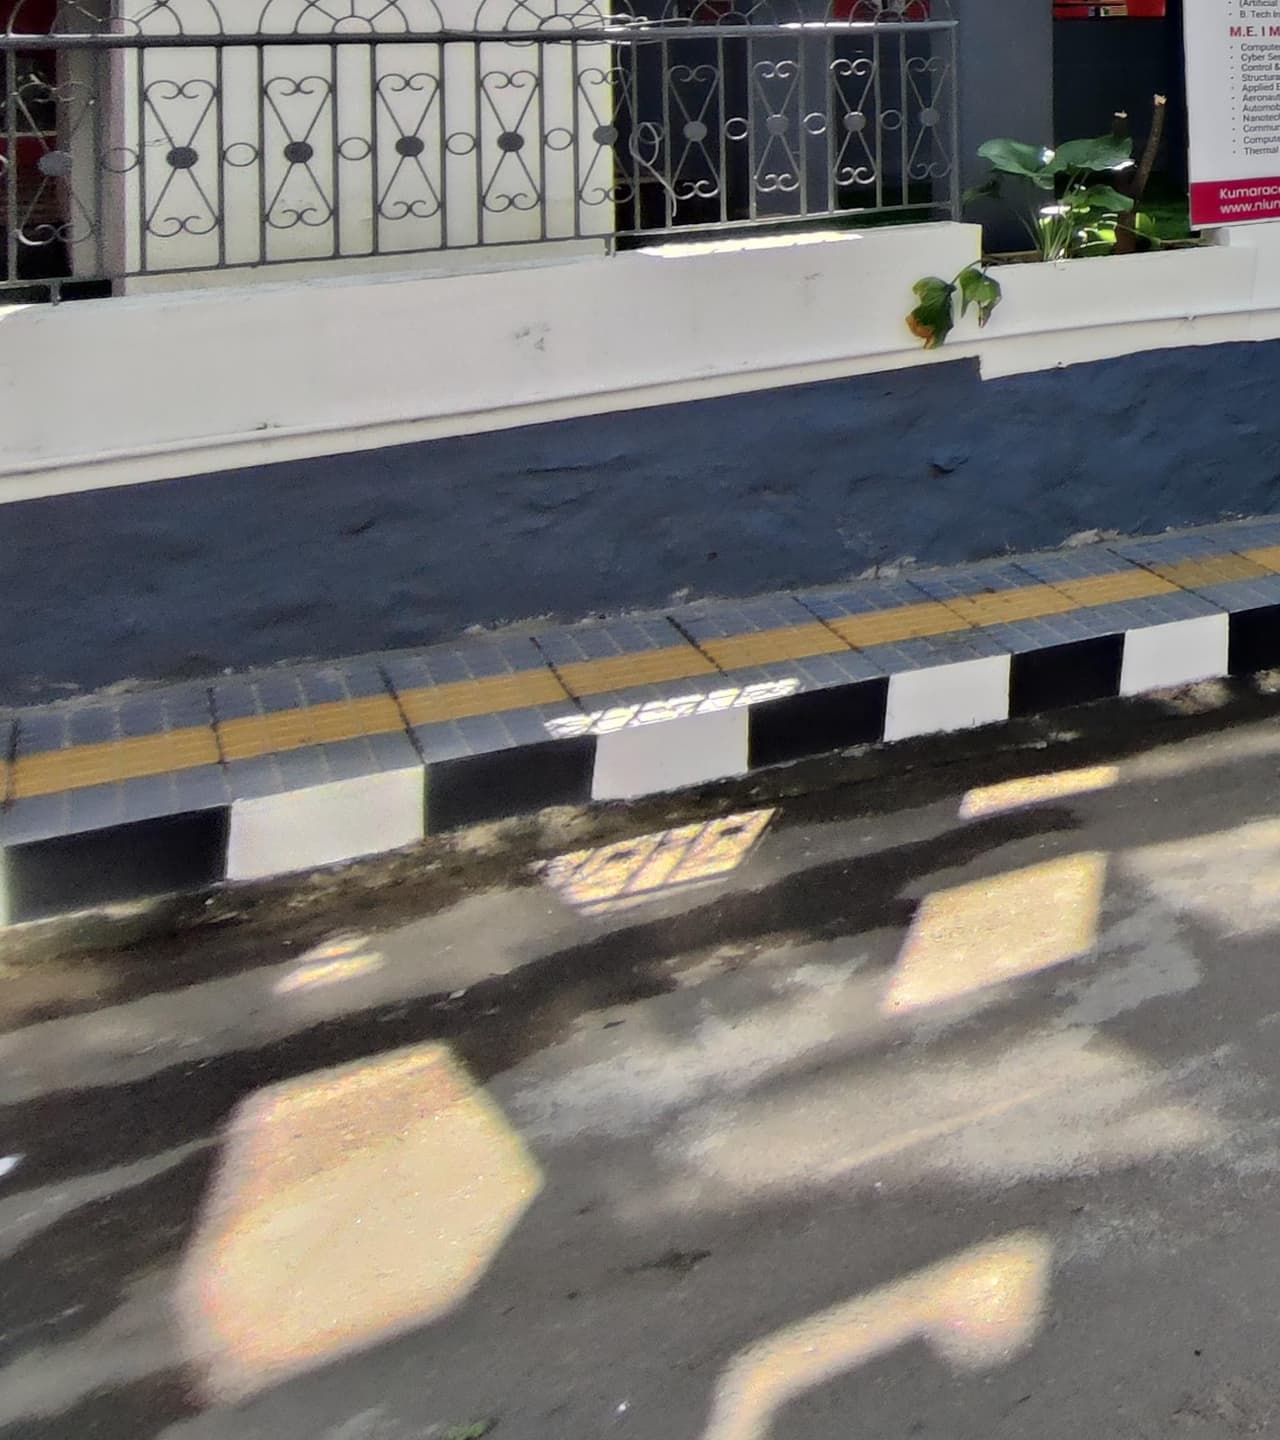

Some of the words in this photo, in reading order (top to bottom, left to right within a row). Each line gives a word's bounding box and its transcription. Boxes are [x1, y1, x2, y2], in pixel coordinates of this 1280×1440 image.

[1250, 10, 1271, 18] Tech
[1229, 26, 1257, 37] M.E.
[1241, 53, 1265, 63] Cyber
[1241, 62, 1272, 72] Control
[1241, 83, 1274, 94] Applied
[1243, 146, 1279, 156] Thermal
